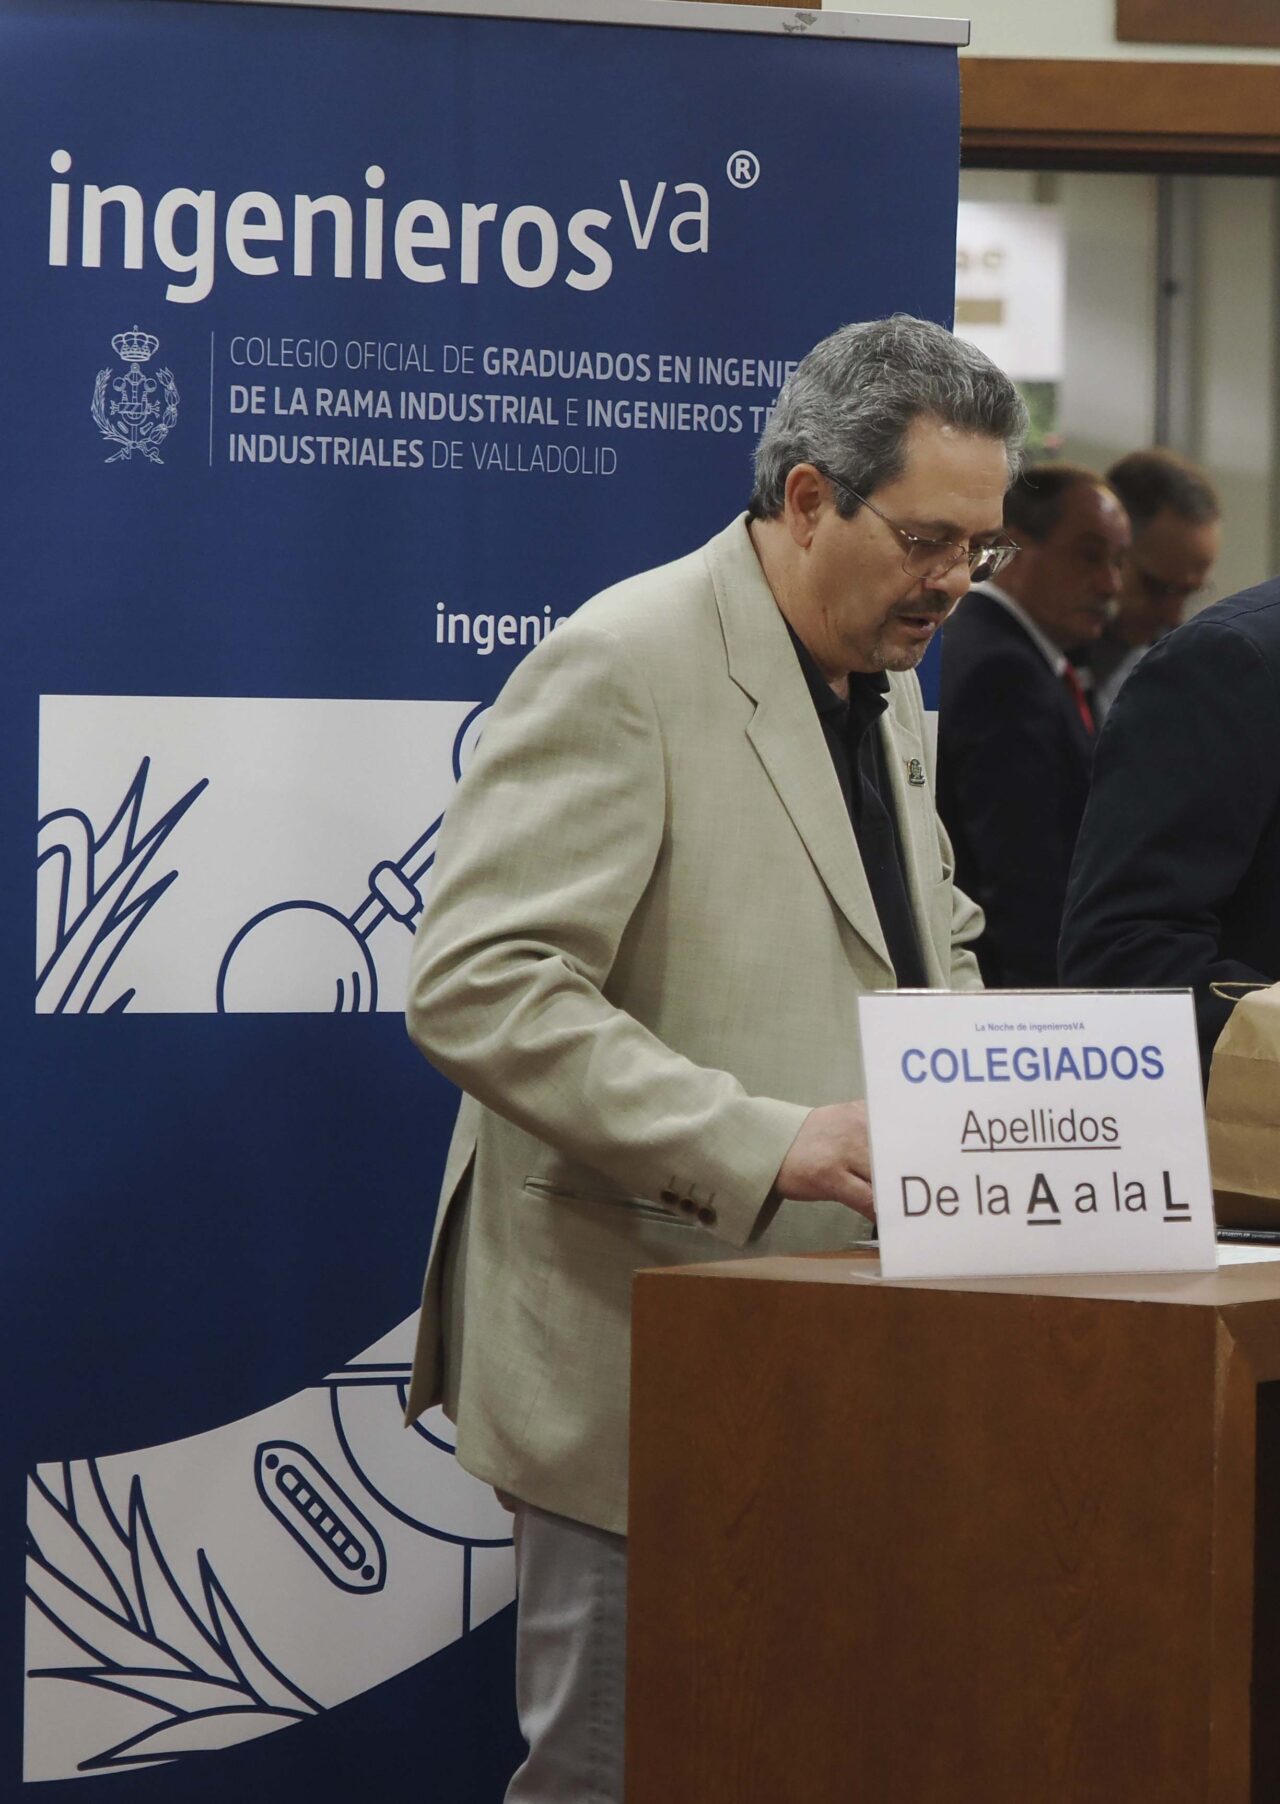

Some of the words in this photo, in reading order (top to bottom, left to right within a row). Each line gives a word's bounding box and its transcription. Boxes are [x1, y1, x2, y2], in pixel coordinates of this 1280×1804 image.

[48, 149, 613, 304] ingenieros
[230, 335, 338, 369] COLEGIO
[344, 340, 435, 373] OFICIAL
[443, 344, 475, 375] DE
[482, 346, 652, 383] GRADUADOS
[658, 354, 692, 384] EN
[230, 384, 266, 415] DE
[274, 386, 309, 416] LA
[315, 387, 393, 419] RAMA
[400, 391, 560, 426] INDUSTRIAL
[566, 397, 579, 427] E
[586, 398, 743, 434] INGENIEROS
[229, 433, 425, 469] INDUSTRIALES
[431, 439, 464, 470] DE
[471, 441, 618, 476] VALLADOLID
[975, 1023, 986, 1032] La
[988, 1023, 1014, 1032] Noche
[1016, 1022, 1027, 1031] de
[901, 1045, 1165, 1083] COLEGIADOS
[961, 1108, 1119, 1150] Apellidos
[901, 1175, 959, 1217] De
[975, 1174, 1011, 1216] la
[1027, 1173, 1060, 1214] A
[1074, 1182, 1098, 1213] a
[1112, 1171, 1147, 1212] la
[1162, 1170, 1190, 1211] L
